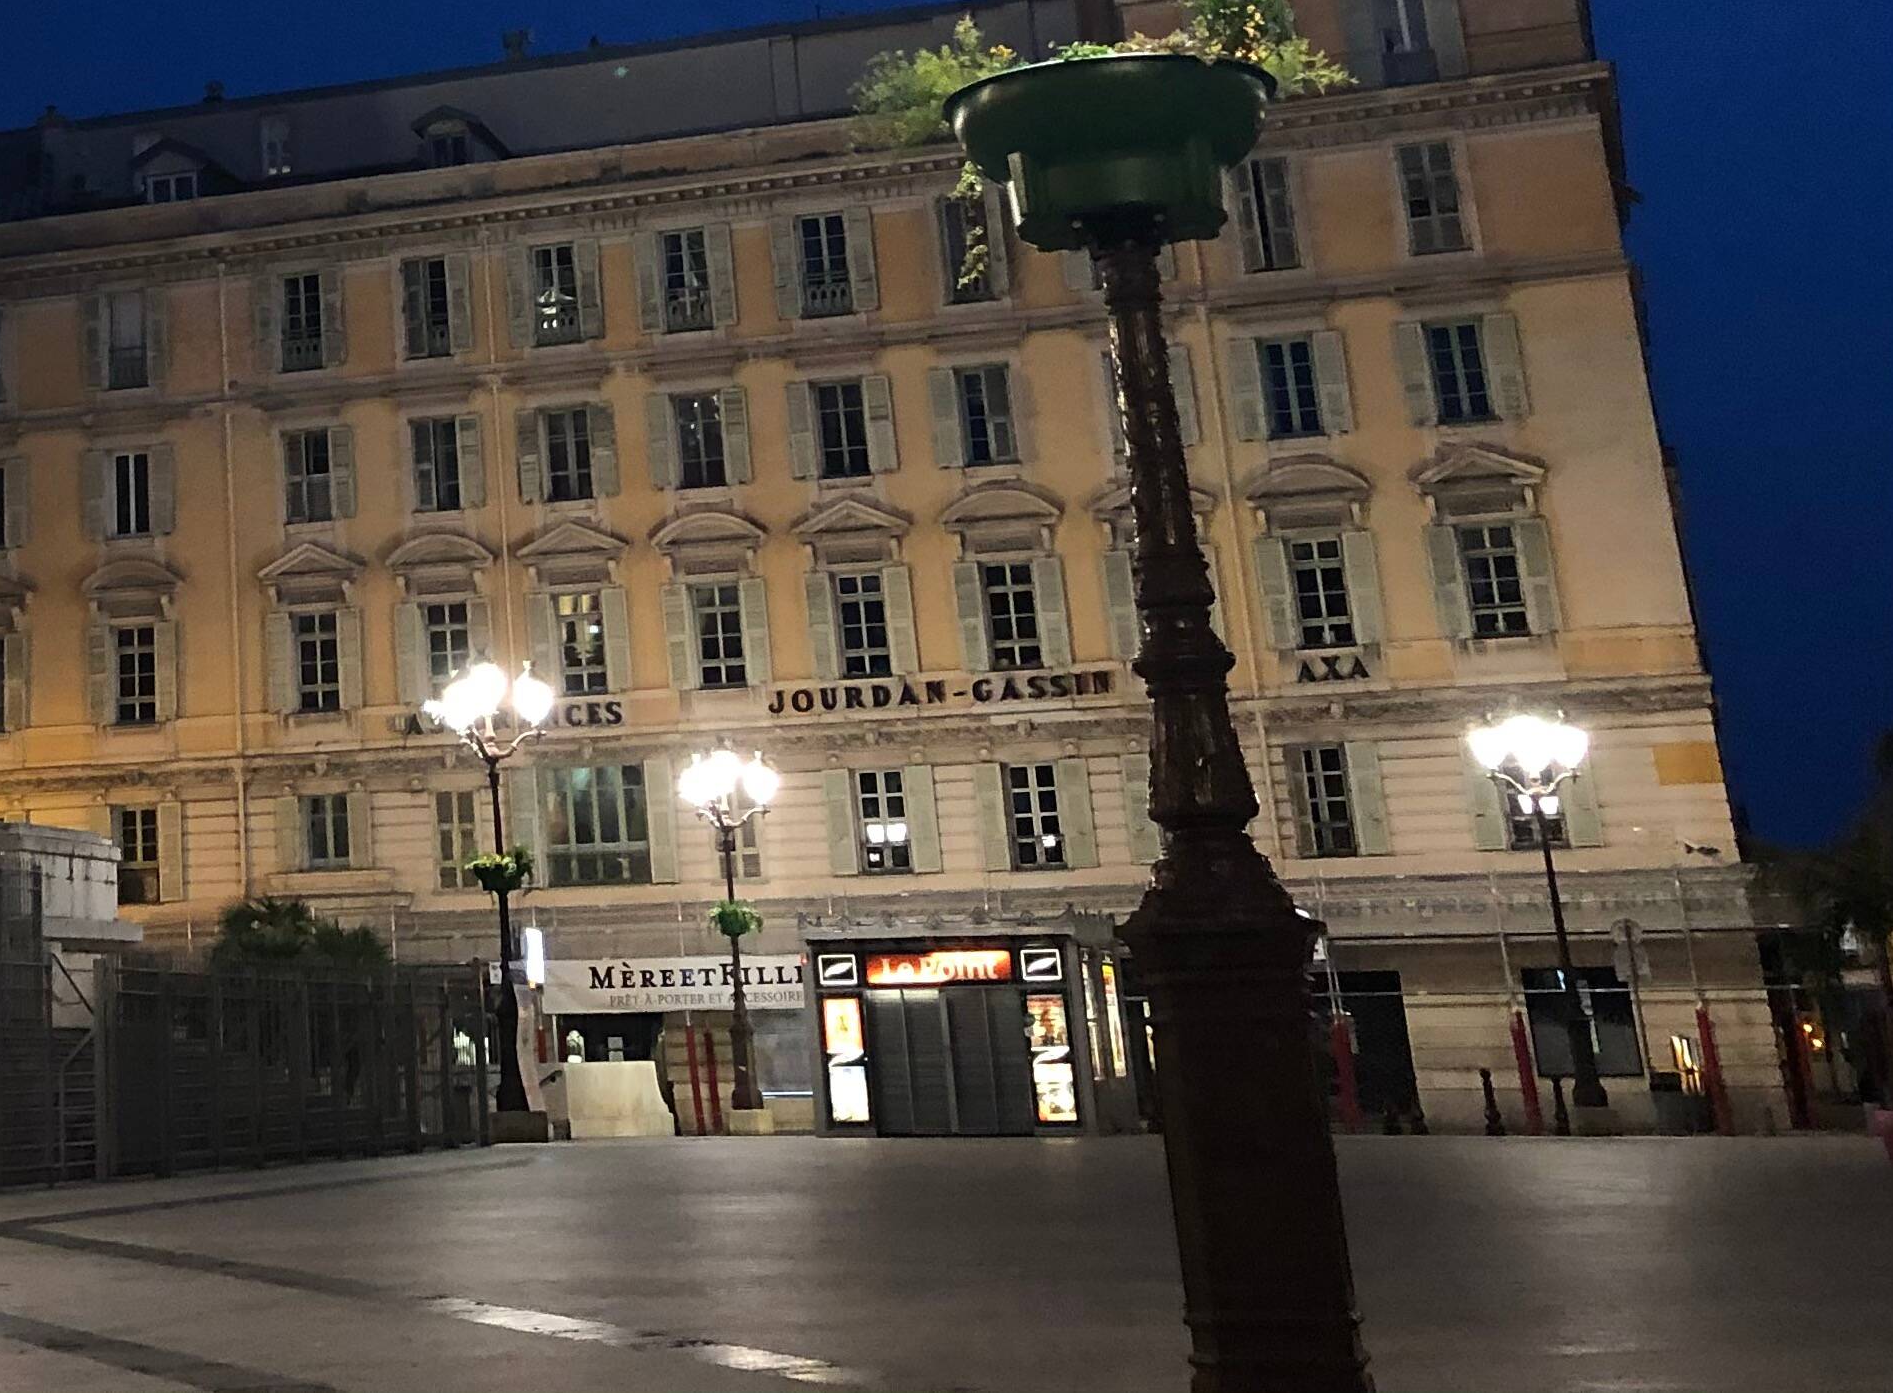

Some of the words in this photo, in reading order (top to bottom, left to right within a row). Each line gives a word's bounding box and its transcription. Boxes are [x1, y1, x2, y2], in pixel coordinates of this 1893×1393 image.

[1298, 655, 1369, 683] AXA
[768, 670, 1111, 714] JOURDAN-GASSIN
[709, 992, 723, 1004] ET
[729, 989, 804, 1003] CESSOIRE
